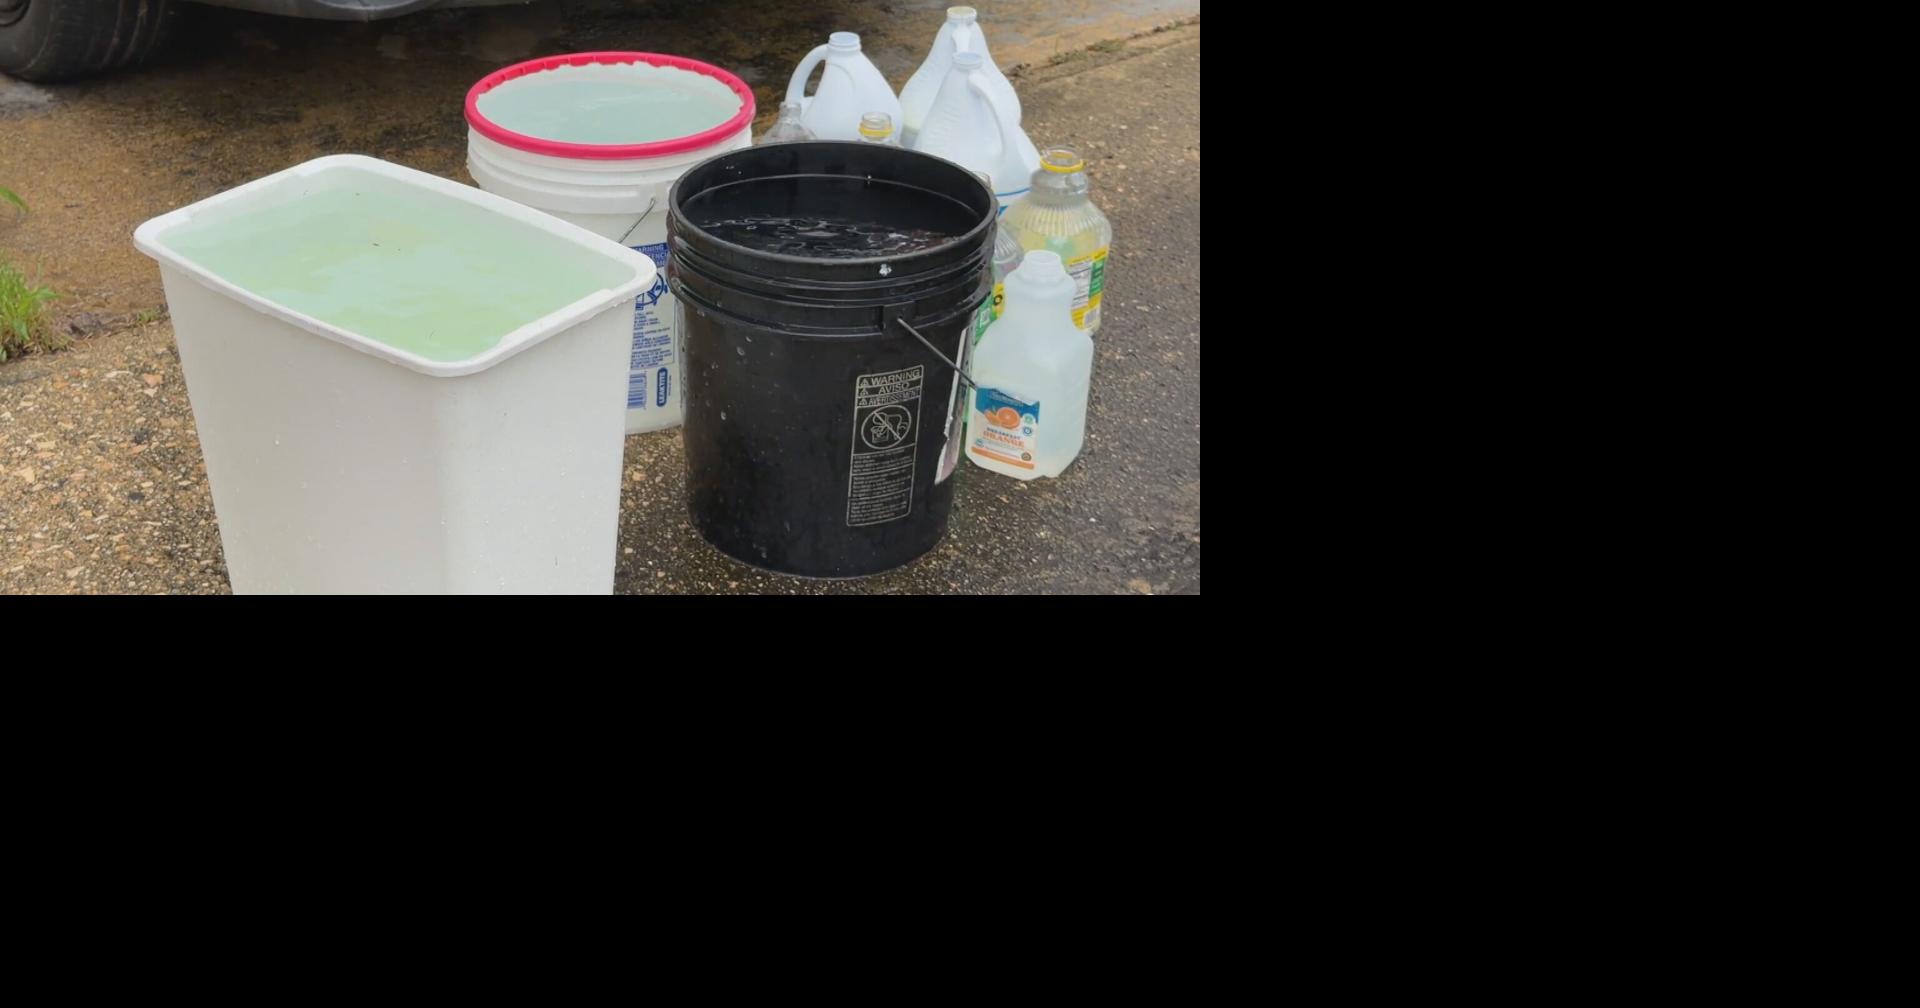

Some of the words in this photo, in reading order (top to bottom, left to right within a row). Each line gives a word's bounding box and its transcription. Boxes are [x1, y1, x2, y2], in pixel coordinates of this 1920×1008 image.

[871, 369, 920, 386] WARNING
[879, 381, 909, 394] AVISO
[983, 430, 1025, 447] ORANGE
